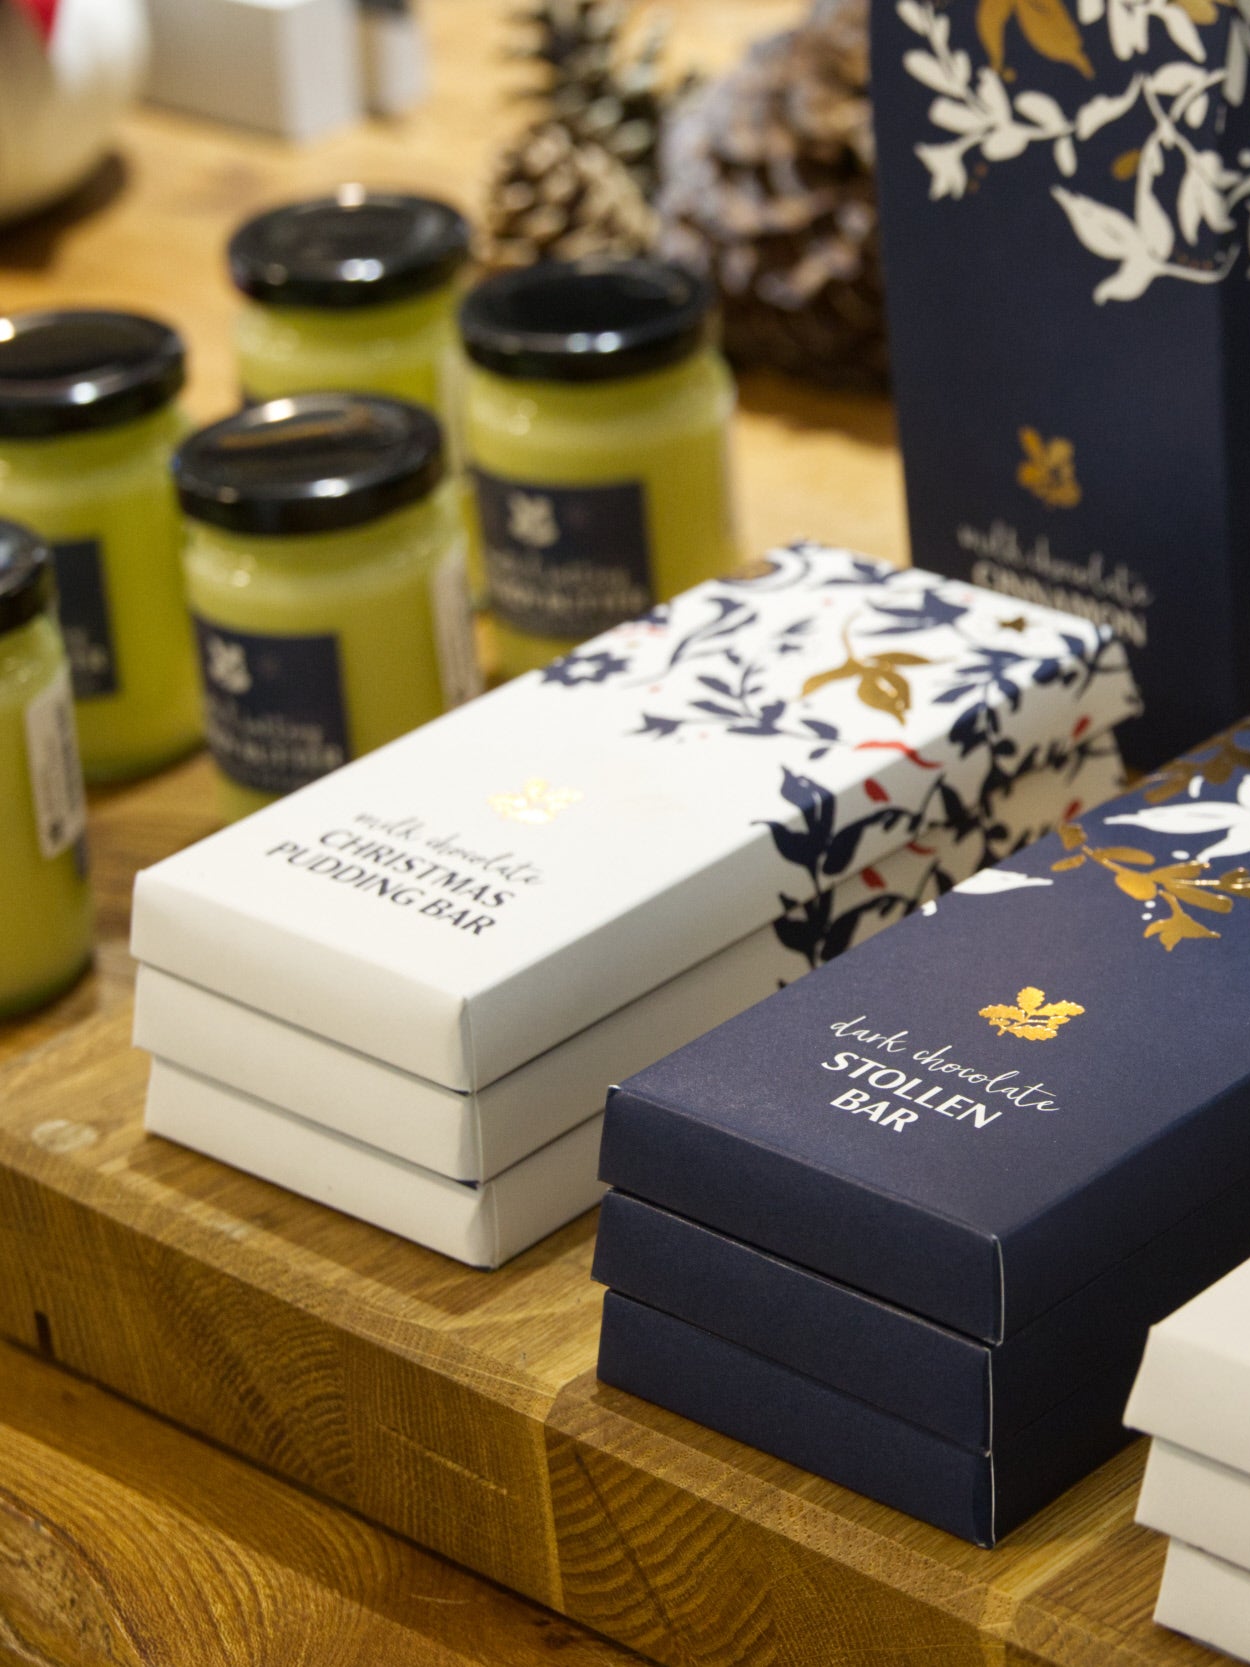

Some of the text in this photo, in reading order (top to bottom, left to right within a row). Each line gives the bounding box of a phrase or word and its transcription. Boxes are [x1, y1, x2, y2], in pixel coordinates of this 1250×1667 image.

[266, 840, 497, 936] PUDDING BAR
[319, 829, 515, 908] CHRISTMAS
[426, 833, 545, 885] chocolate
[821, 1052, 1002, 1129] STOLLEN
[830, 1015, 1060, 1111] dark chocolate
[830, 1087, 919, 1133] BAR
